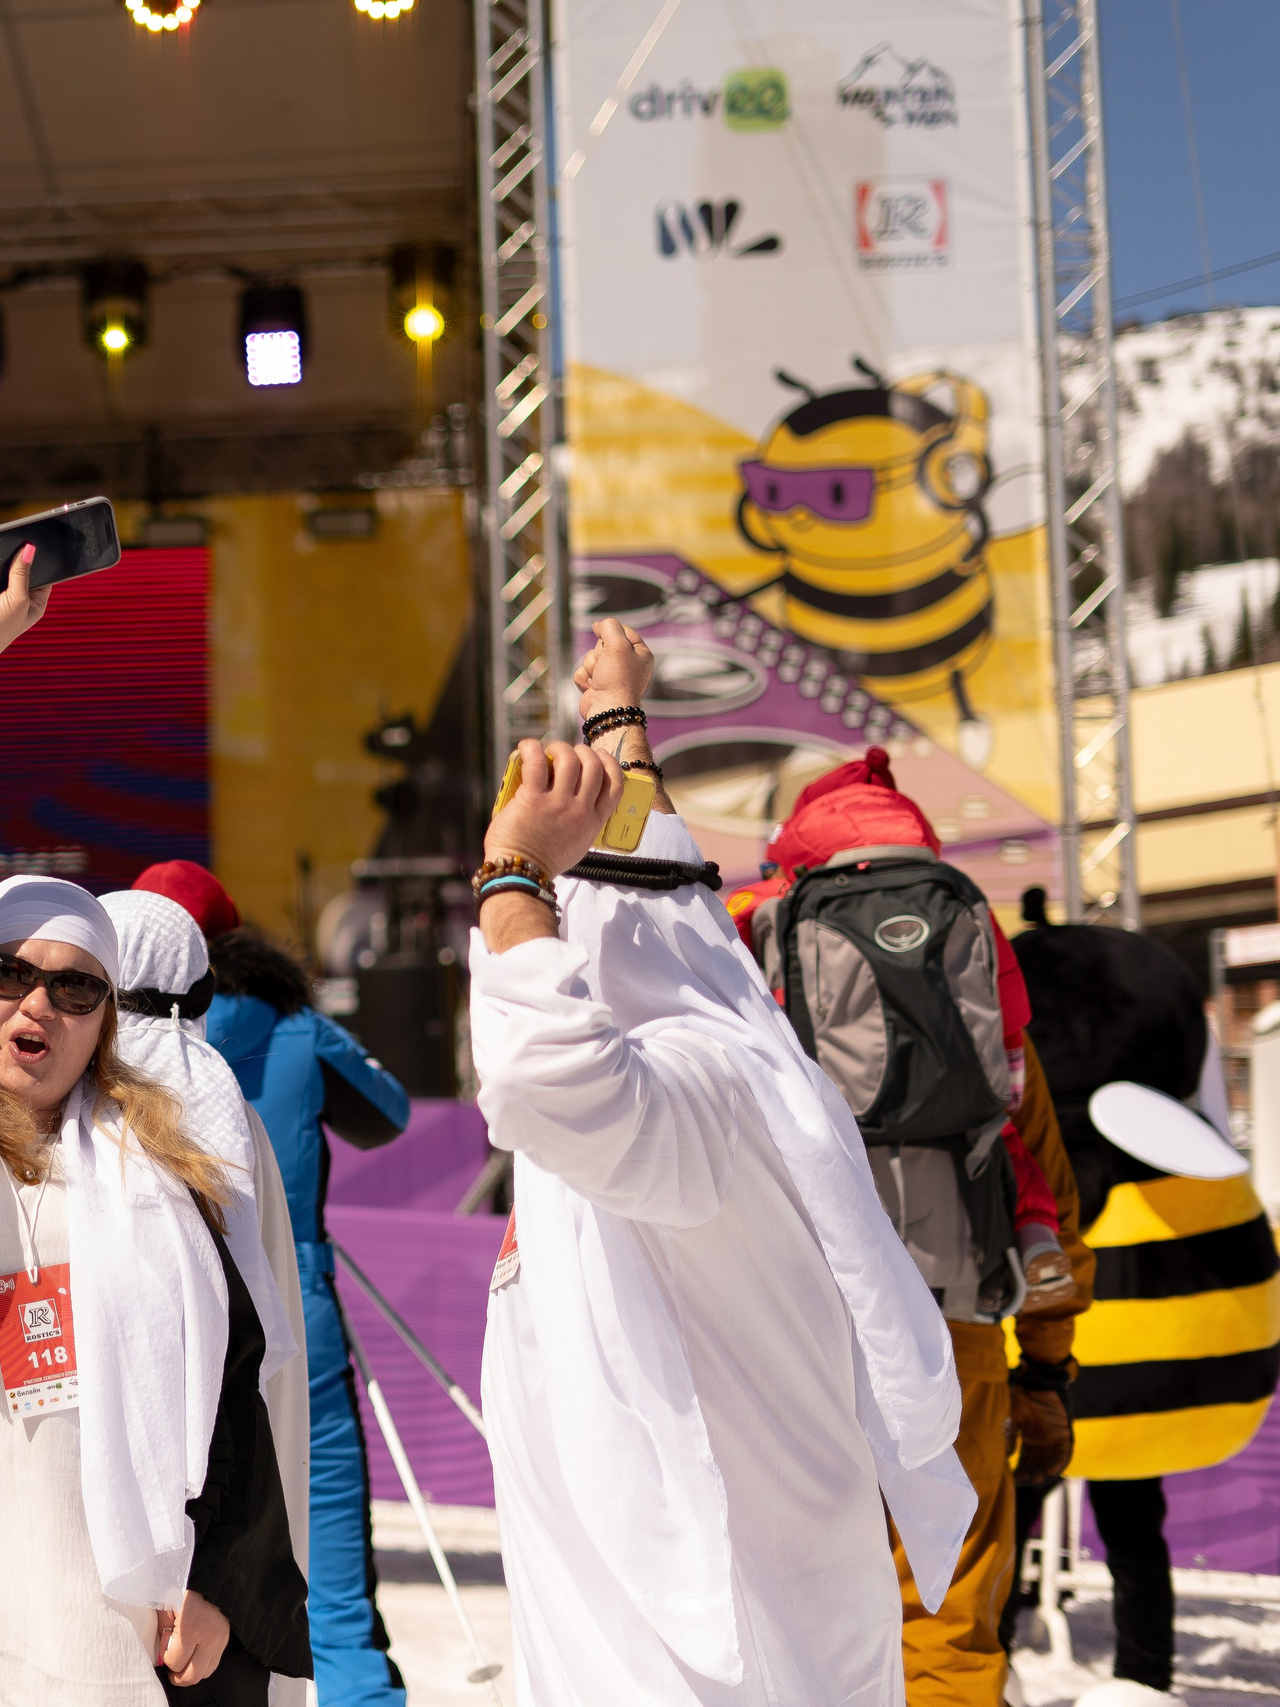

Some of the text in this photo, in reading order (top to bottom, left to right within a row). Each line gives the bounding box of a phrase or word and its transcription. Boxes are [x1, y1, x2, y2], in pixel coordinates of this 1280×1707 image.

[29, 1307, 51, 1328] R
[26, 1330, 60, 1341] ROSTIC'S
[27, 1346, 68, 1368] 118
[16, 1387, 41, 1397] билайн
